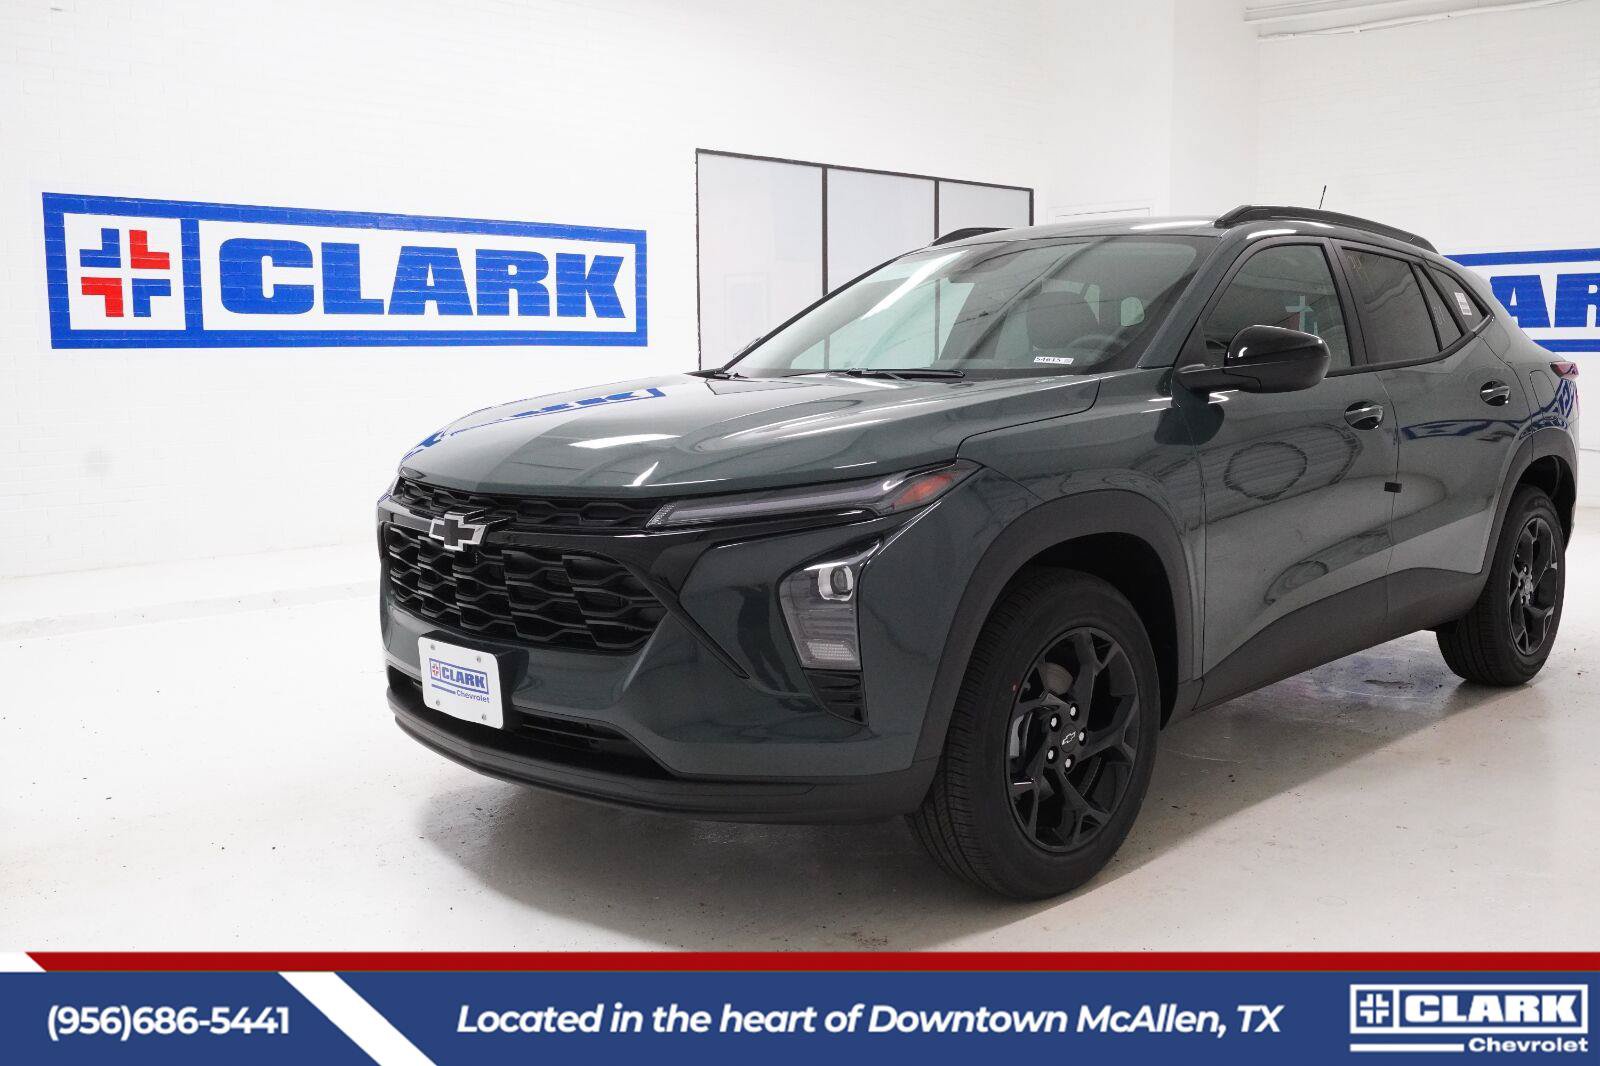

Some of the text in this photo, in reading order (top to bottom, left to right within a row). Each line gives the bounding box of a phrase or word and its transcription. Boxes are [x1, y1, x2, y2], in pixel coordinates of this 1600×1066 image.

[219, 237, 626, 319] CLARK
[441, 667, 485, 688] CLARK
[456, 690, 490, 703] Chevrolet
